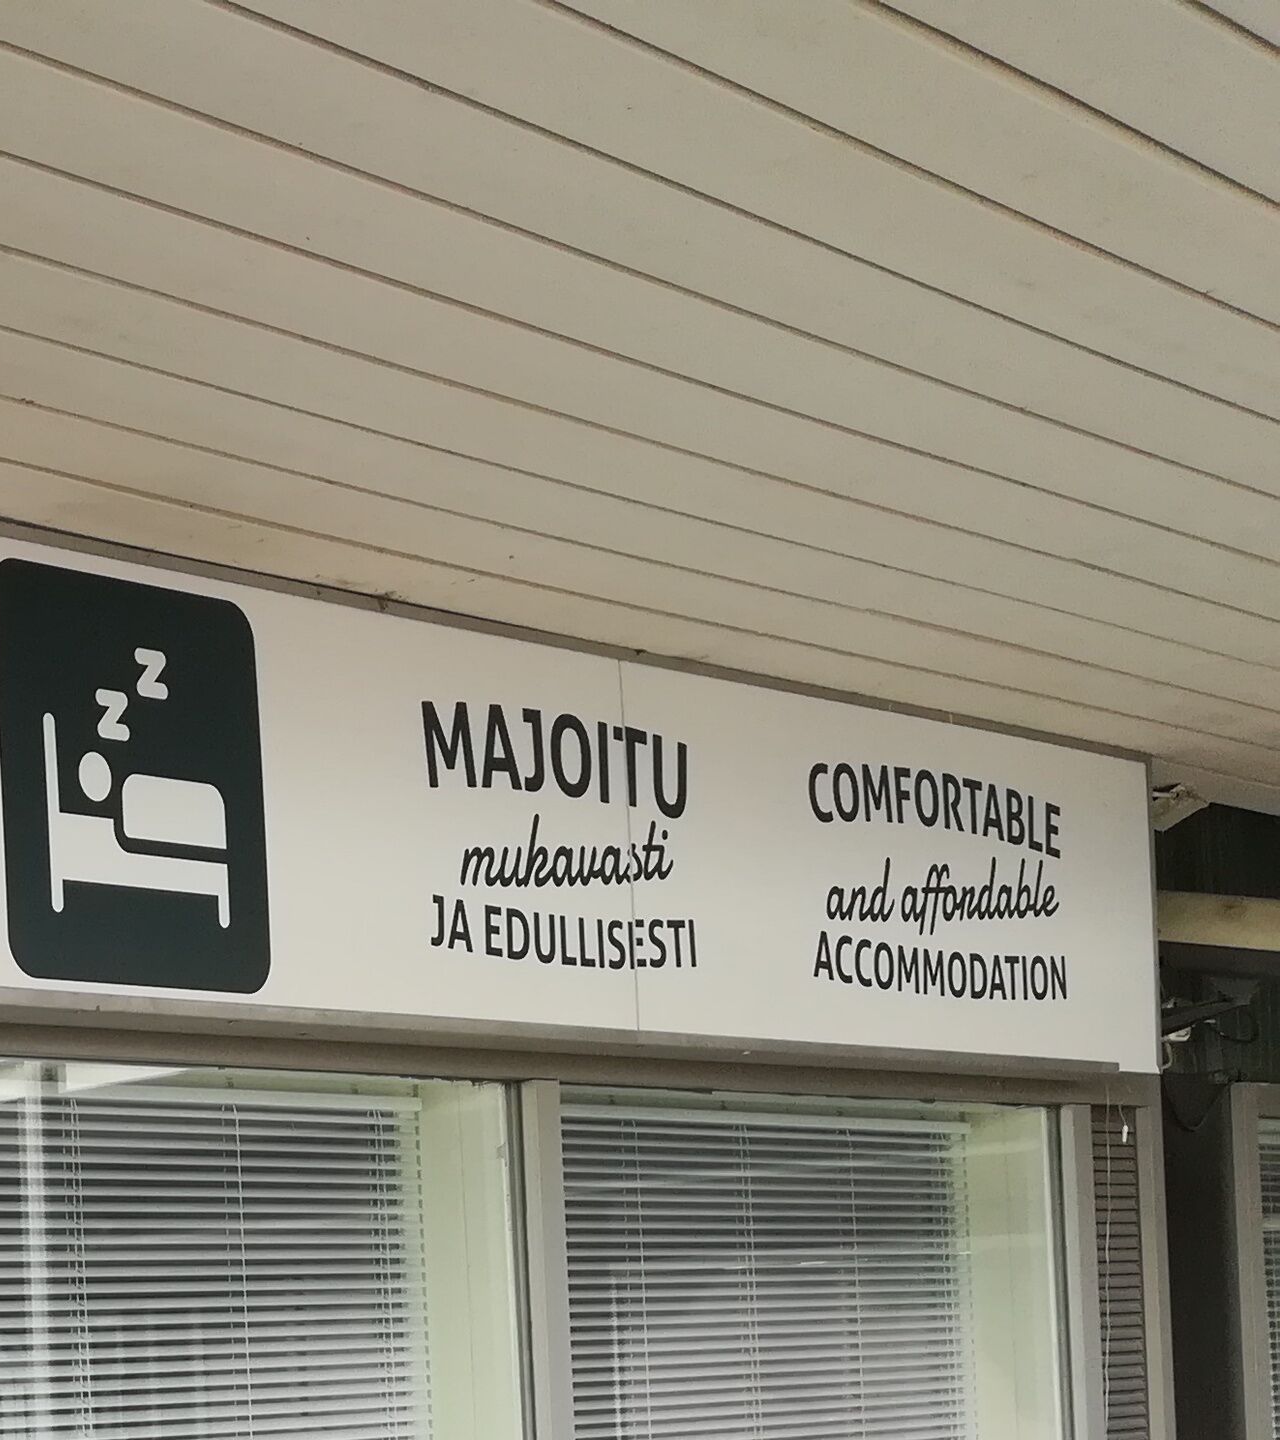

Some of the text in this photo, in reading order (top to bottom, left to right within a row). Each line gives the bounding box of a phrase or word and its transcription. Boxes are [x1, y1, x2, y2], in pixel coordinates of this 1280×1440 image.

[421, 700, 688, 819] MAJOITU
[808, 762, 1062, 860] COMFORTABLE
[460, 813, 675, 889] mukavasti
[430, 894, 698, 970] JA EDULLISESTI
[826, 856, 1061, 936] and affordable
[813, 930, 1069, 1001] ACCOMMODATION
